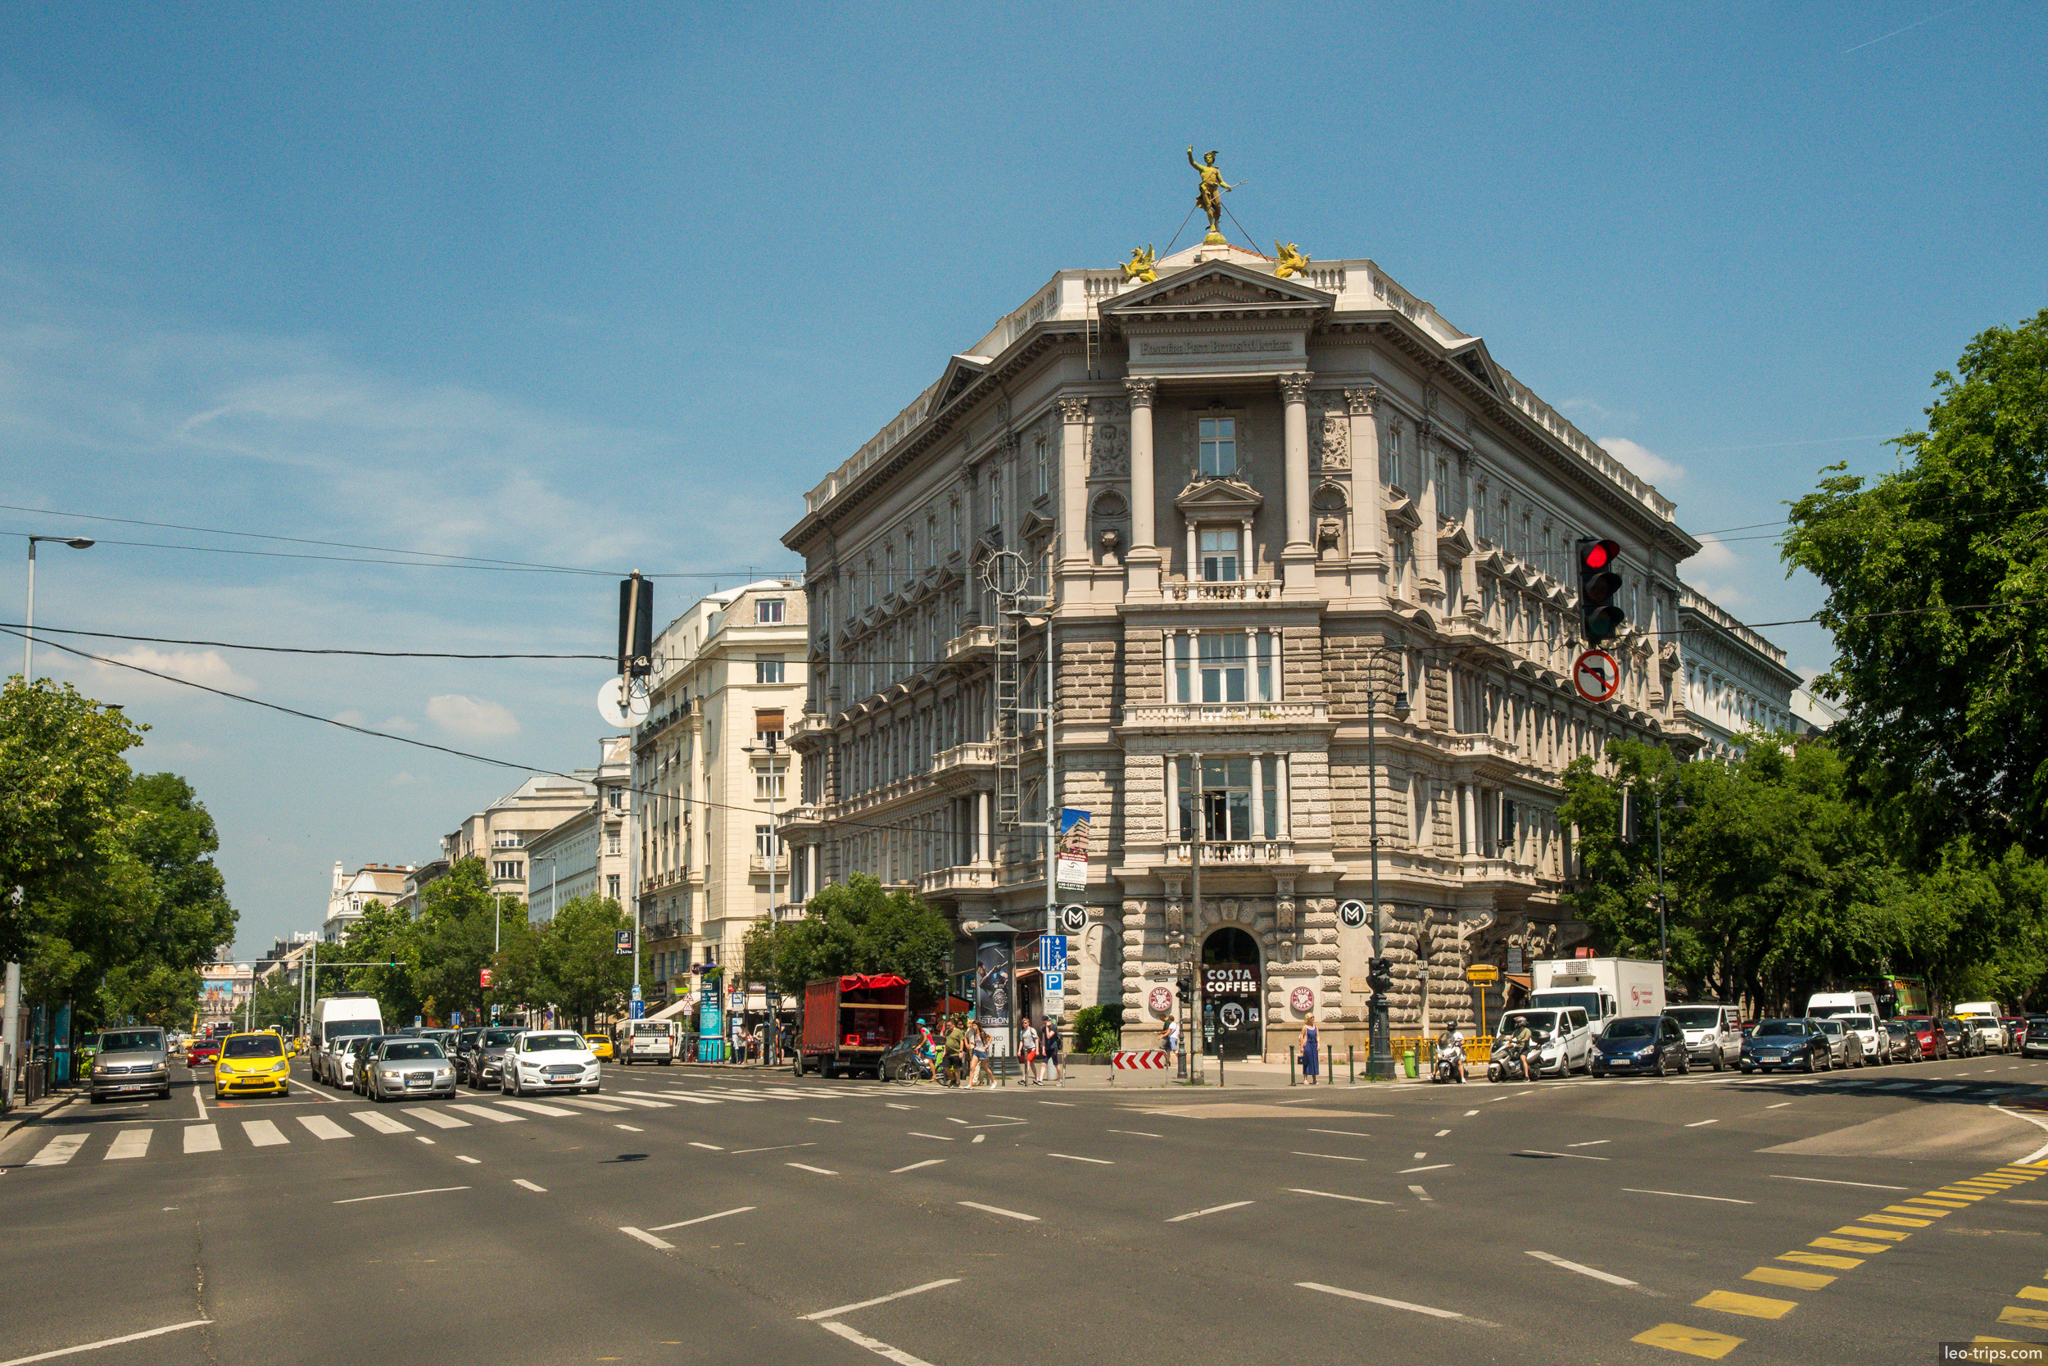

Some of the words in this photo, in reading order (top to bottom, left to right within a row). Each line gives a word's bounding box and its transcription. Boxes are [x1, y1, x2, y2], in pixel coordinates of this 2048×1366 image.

[1207, 969, 1252, 981] COSTA
[1048, 975, 1059, 989] P
[1206, 981, 1257, 992] COFFEE
